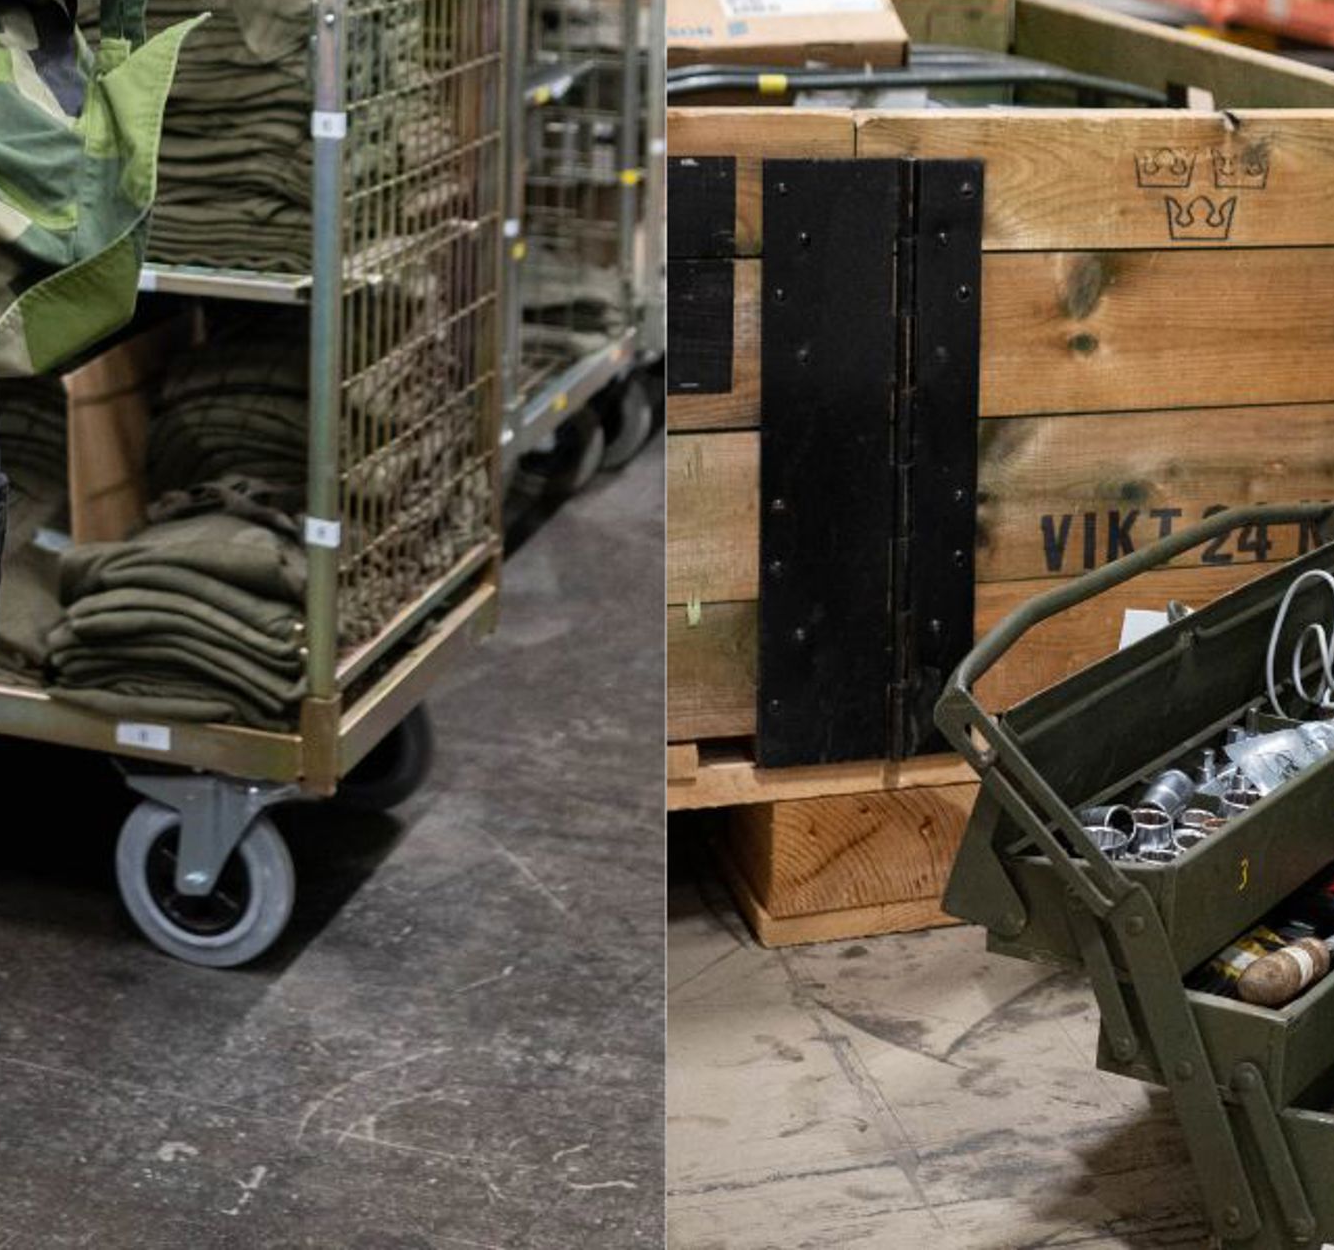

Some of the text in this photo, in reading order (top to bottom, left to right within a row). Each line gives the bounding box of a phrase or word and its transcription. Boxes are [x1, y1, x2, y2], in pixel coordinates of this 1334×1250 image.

[1041, 506, 1183, 573] VIKT
[1201, 503, 1271, 566] 24
[1236, 857, 1251, 893] 3
